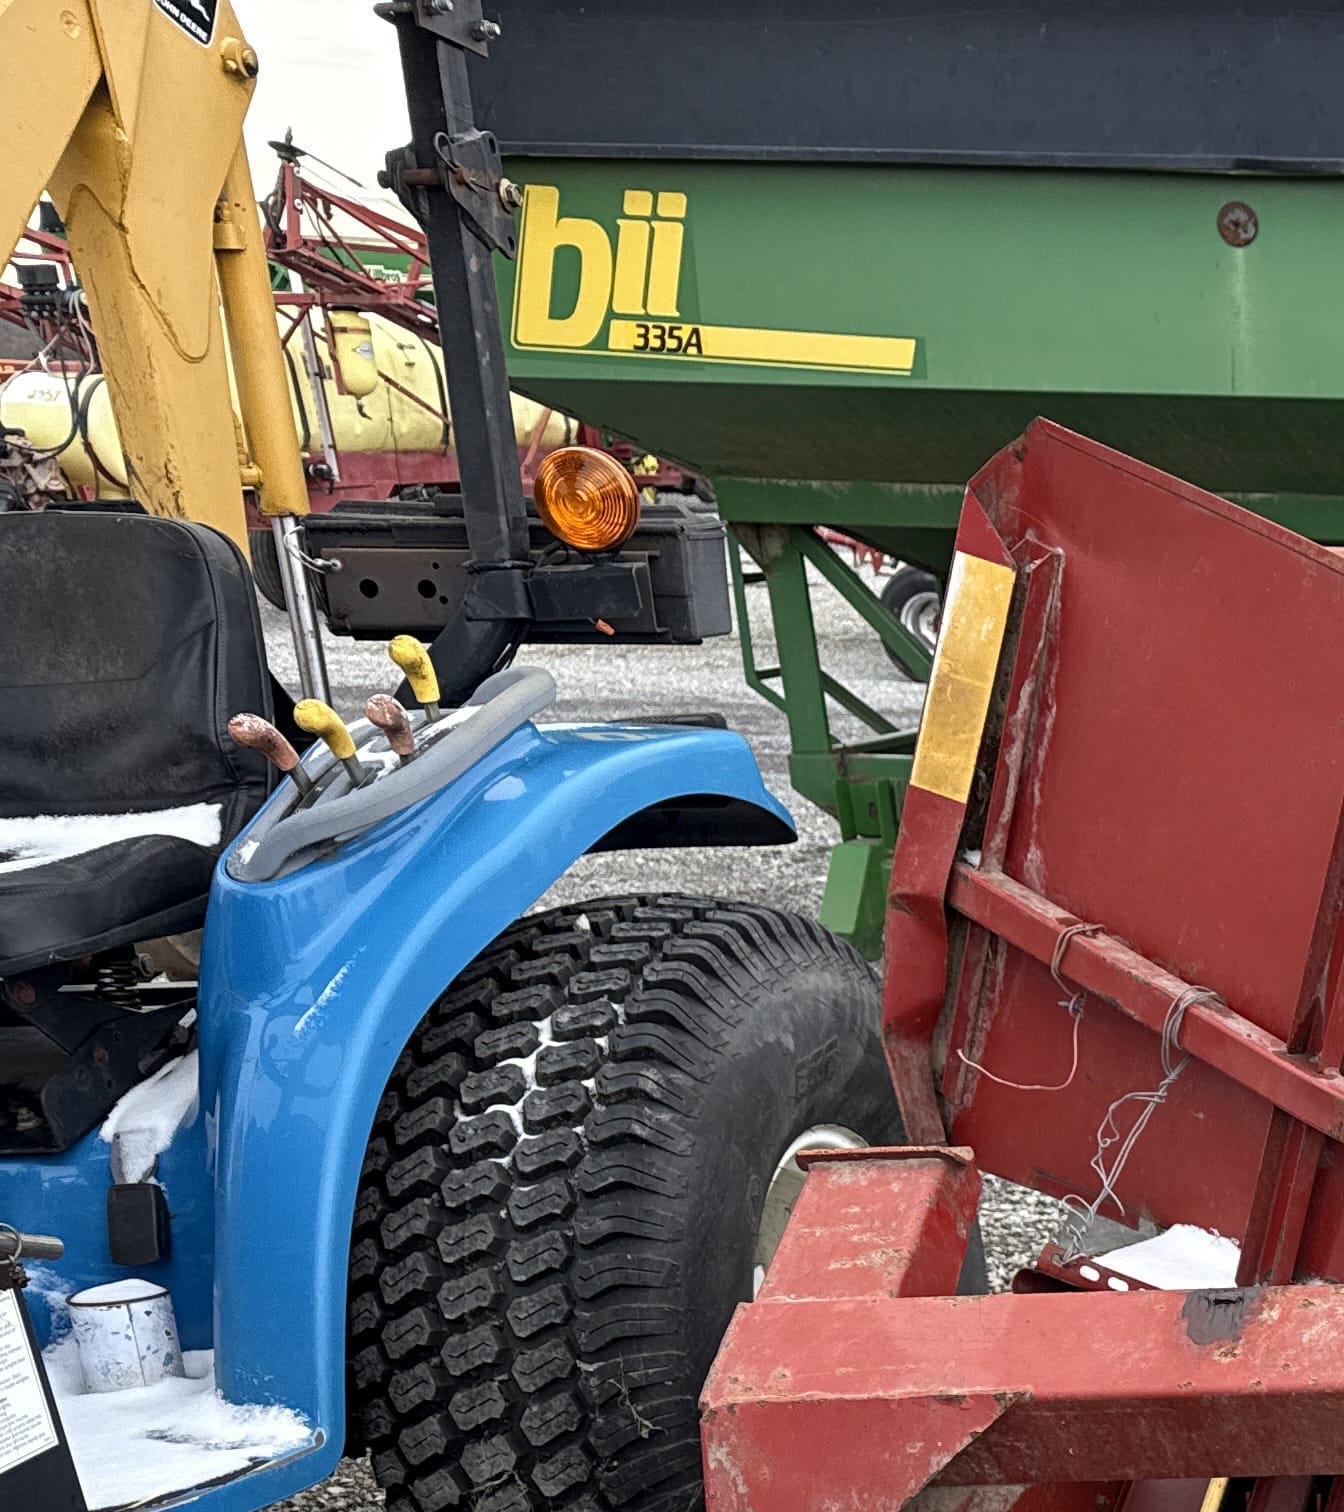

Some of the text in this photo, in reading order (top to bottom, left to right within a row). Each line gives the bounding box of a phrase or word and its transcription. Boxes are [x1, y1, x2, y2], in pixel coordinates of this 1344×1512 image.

[180, 12, 208, 42] DEERE
[516, 184, 687, 348] bii
[633, 323, 703, 355] 335A
